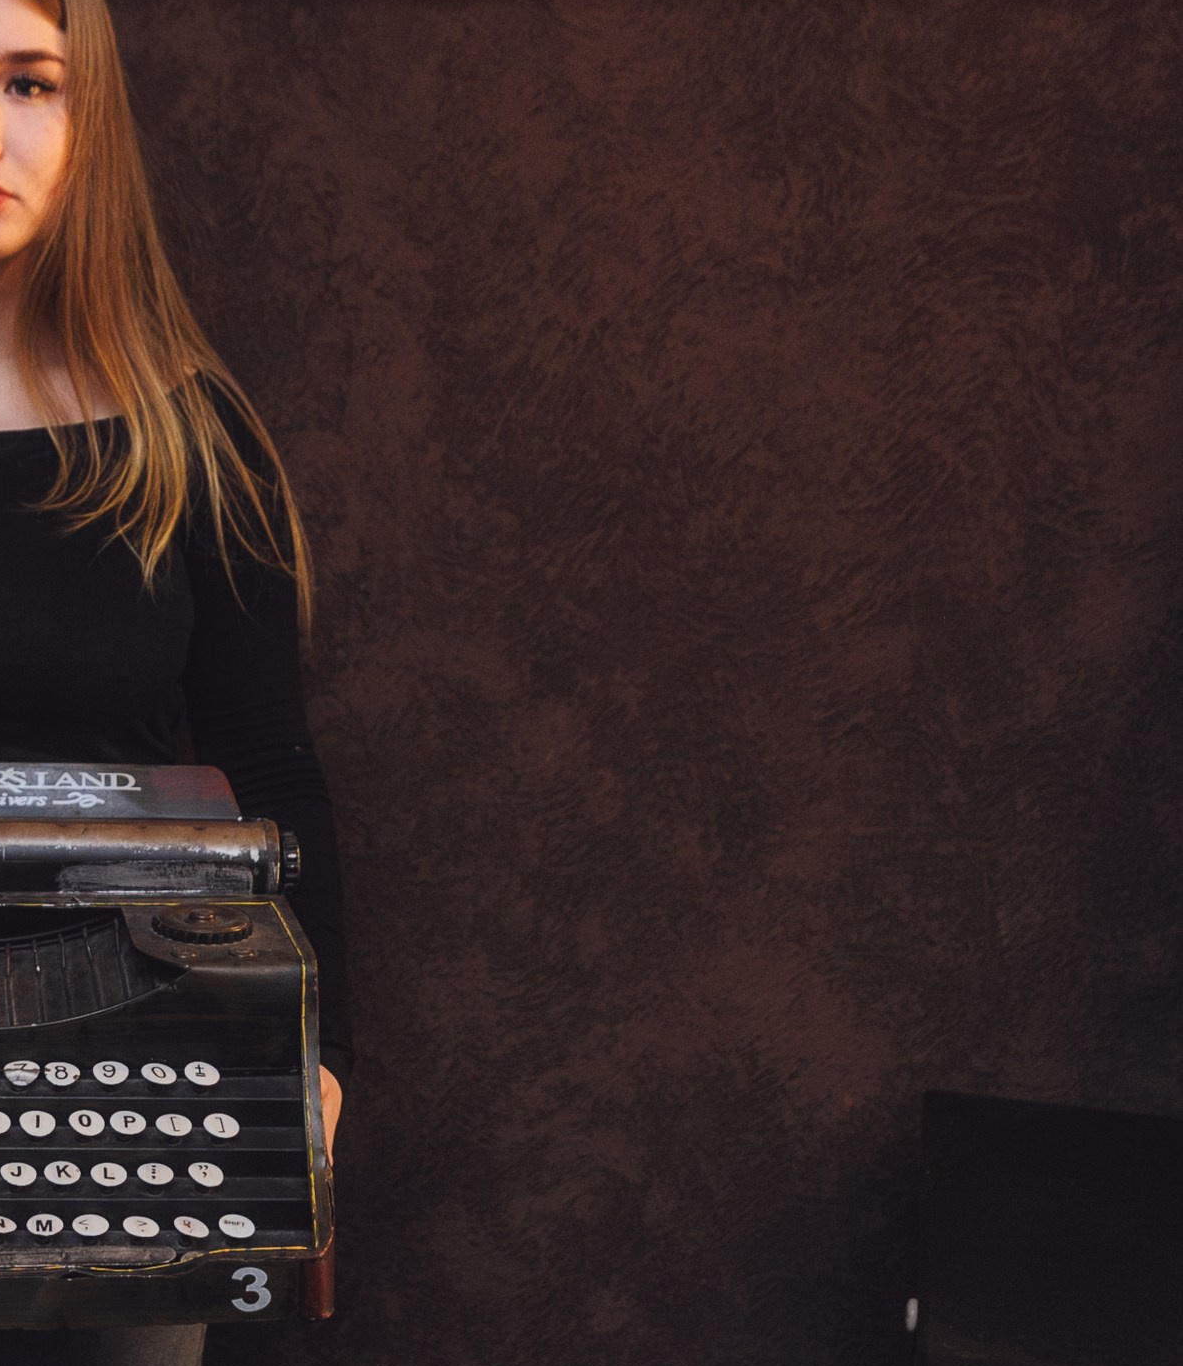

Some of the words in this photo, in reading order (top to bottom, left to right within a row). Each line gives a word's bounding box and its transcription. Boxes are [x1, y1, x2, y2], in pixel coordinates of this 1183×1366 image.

[55, 1065, 68, 1080] 8
[102, 1064, 116, 1078] 9
[123, 1116, 136, 1128] P
[10, 1166, 21, 1177] J
[56, 1165, 72, 1178] K
[103, 1167, 115, 1180] L
[36, 1220, 52, 1232] M
[223, 1219, 245, 1227] SHIFT
[231, 1267, 272, 1312] 3
